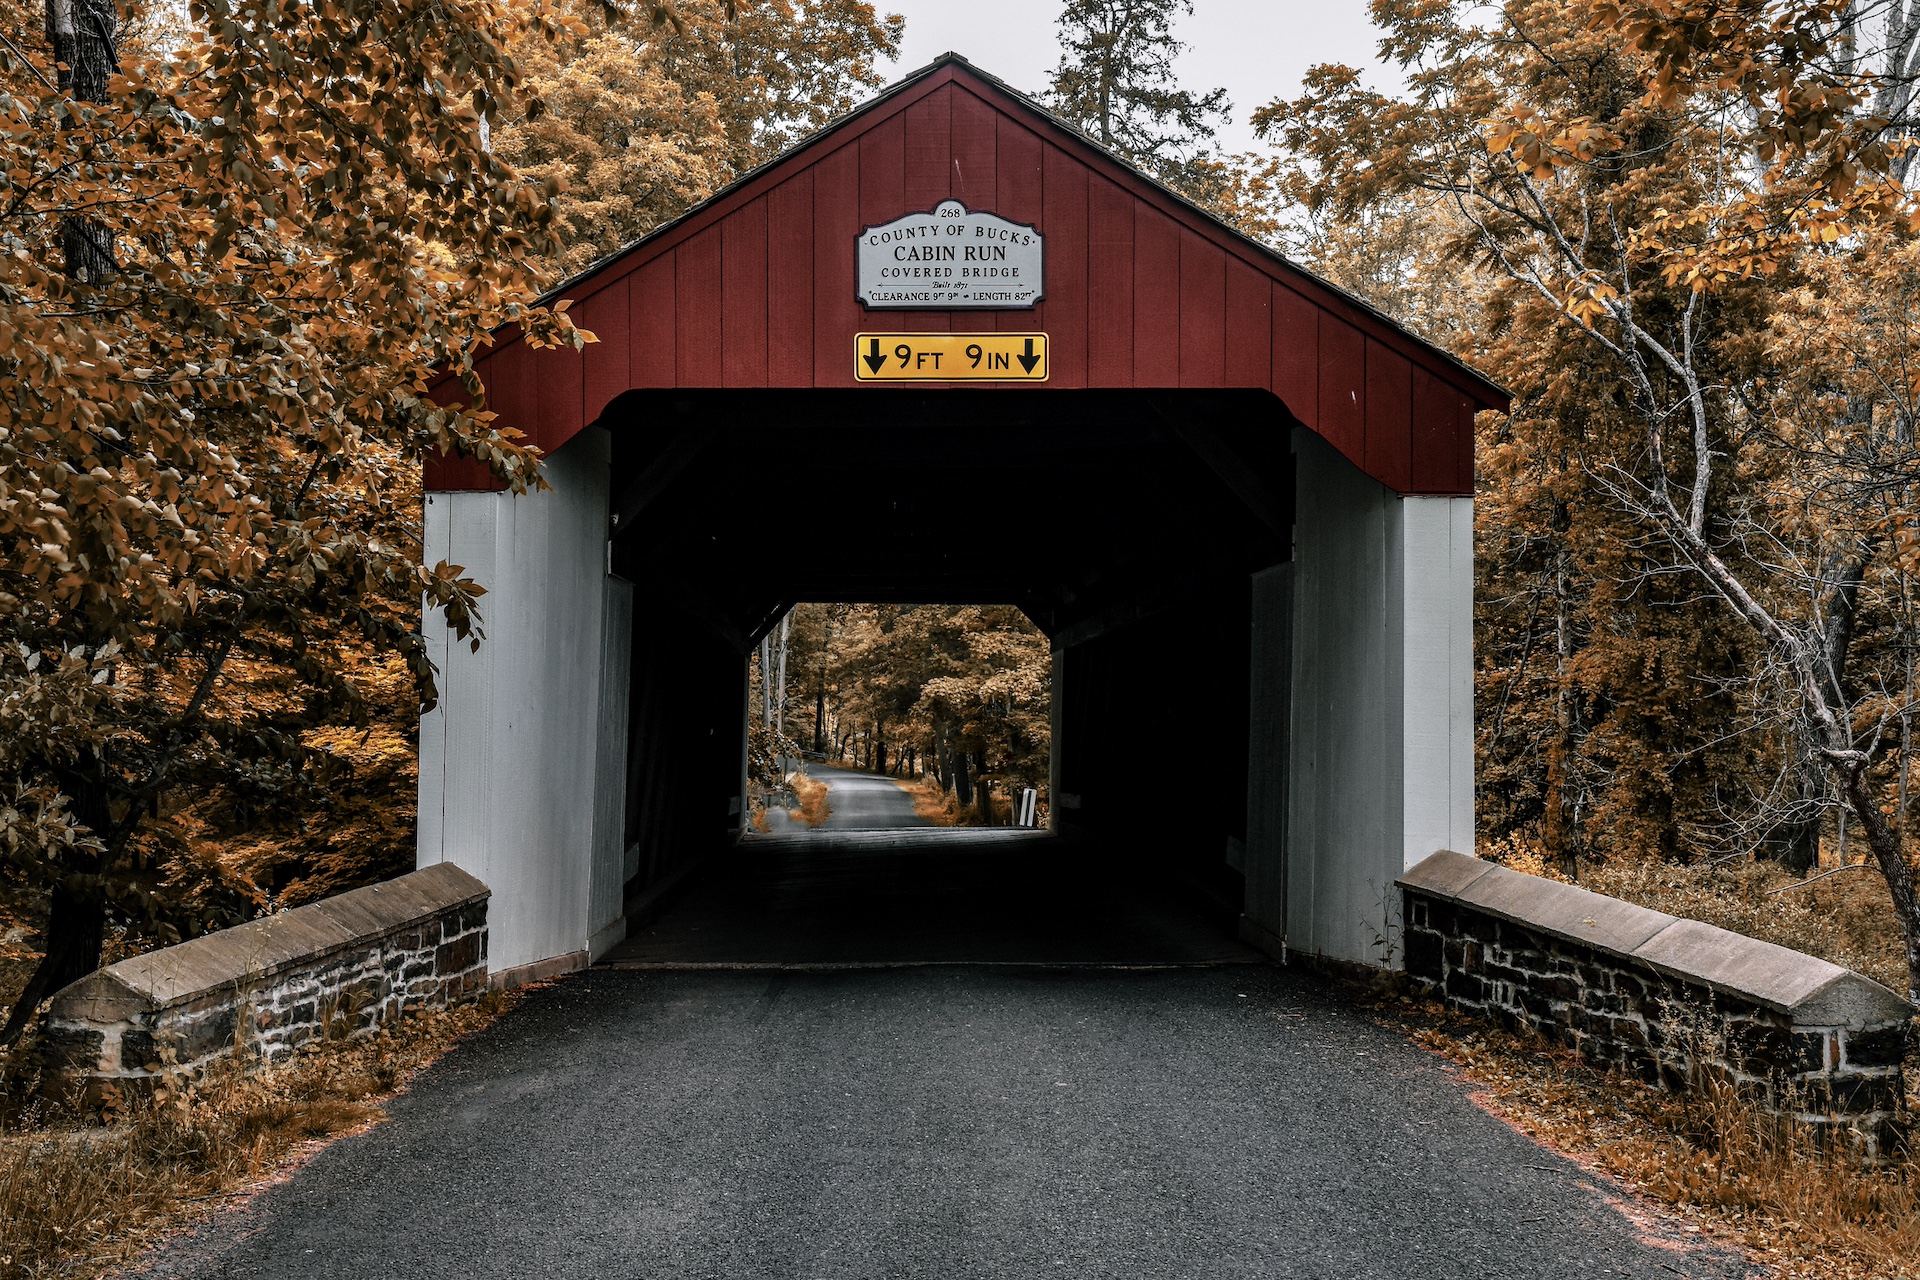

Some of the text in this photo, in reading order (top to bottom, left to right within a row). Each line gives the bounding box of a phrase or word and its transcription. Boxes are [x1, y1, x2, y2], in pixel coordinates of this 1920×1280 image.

[941, 208, 960, 218] 268
[870, 225, 940, 246] COUNTY
[946, 225, 965, 236] OF
[894, 246, 1007, 261] CABIN RUN
[881, 268, 1020, 278] COVERED BRIDGE
[871, 292, 930, 301] CLEARANCE
[973, 292, 1012, 301] LENGTH
